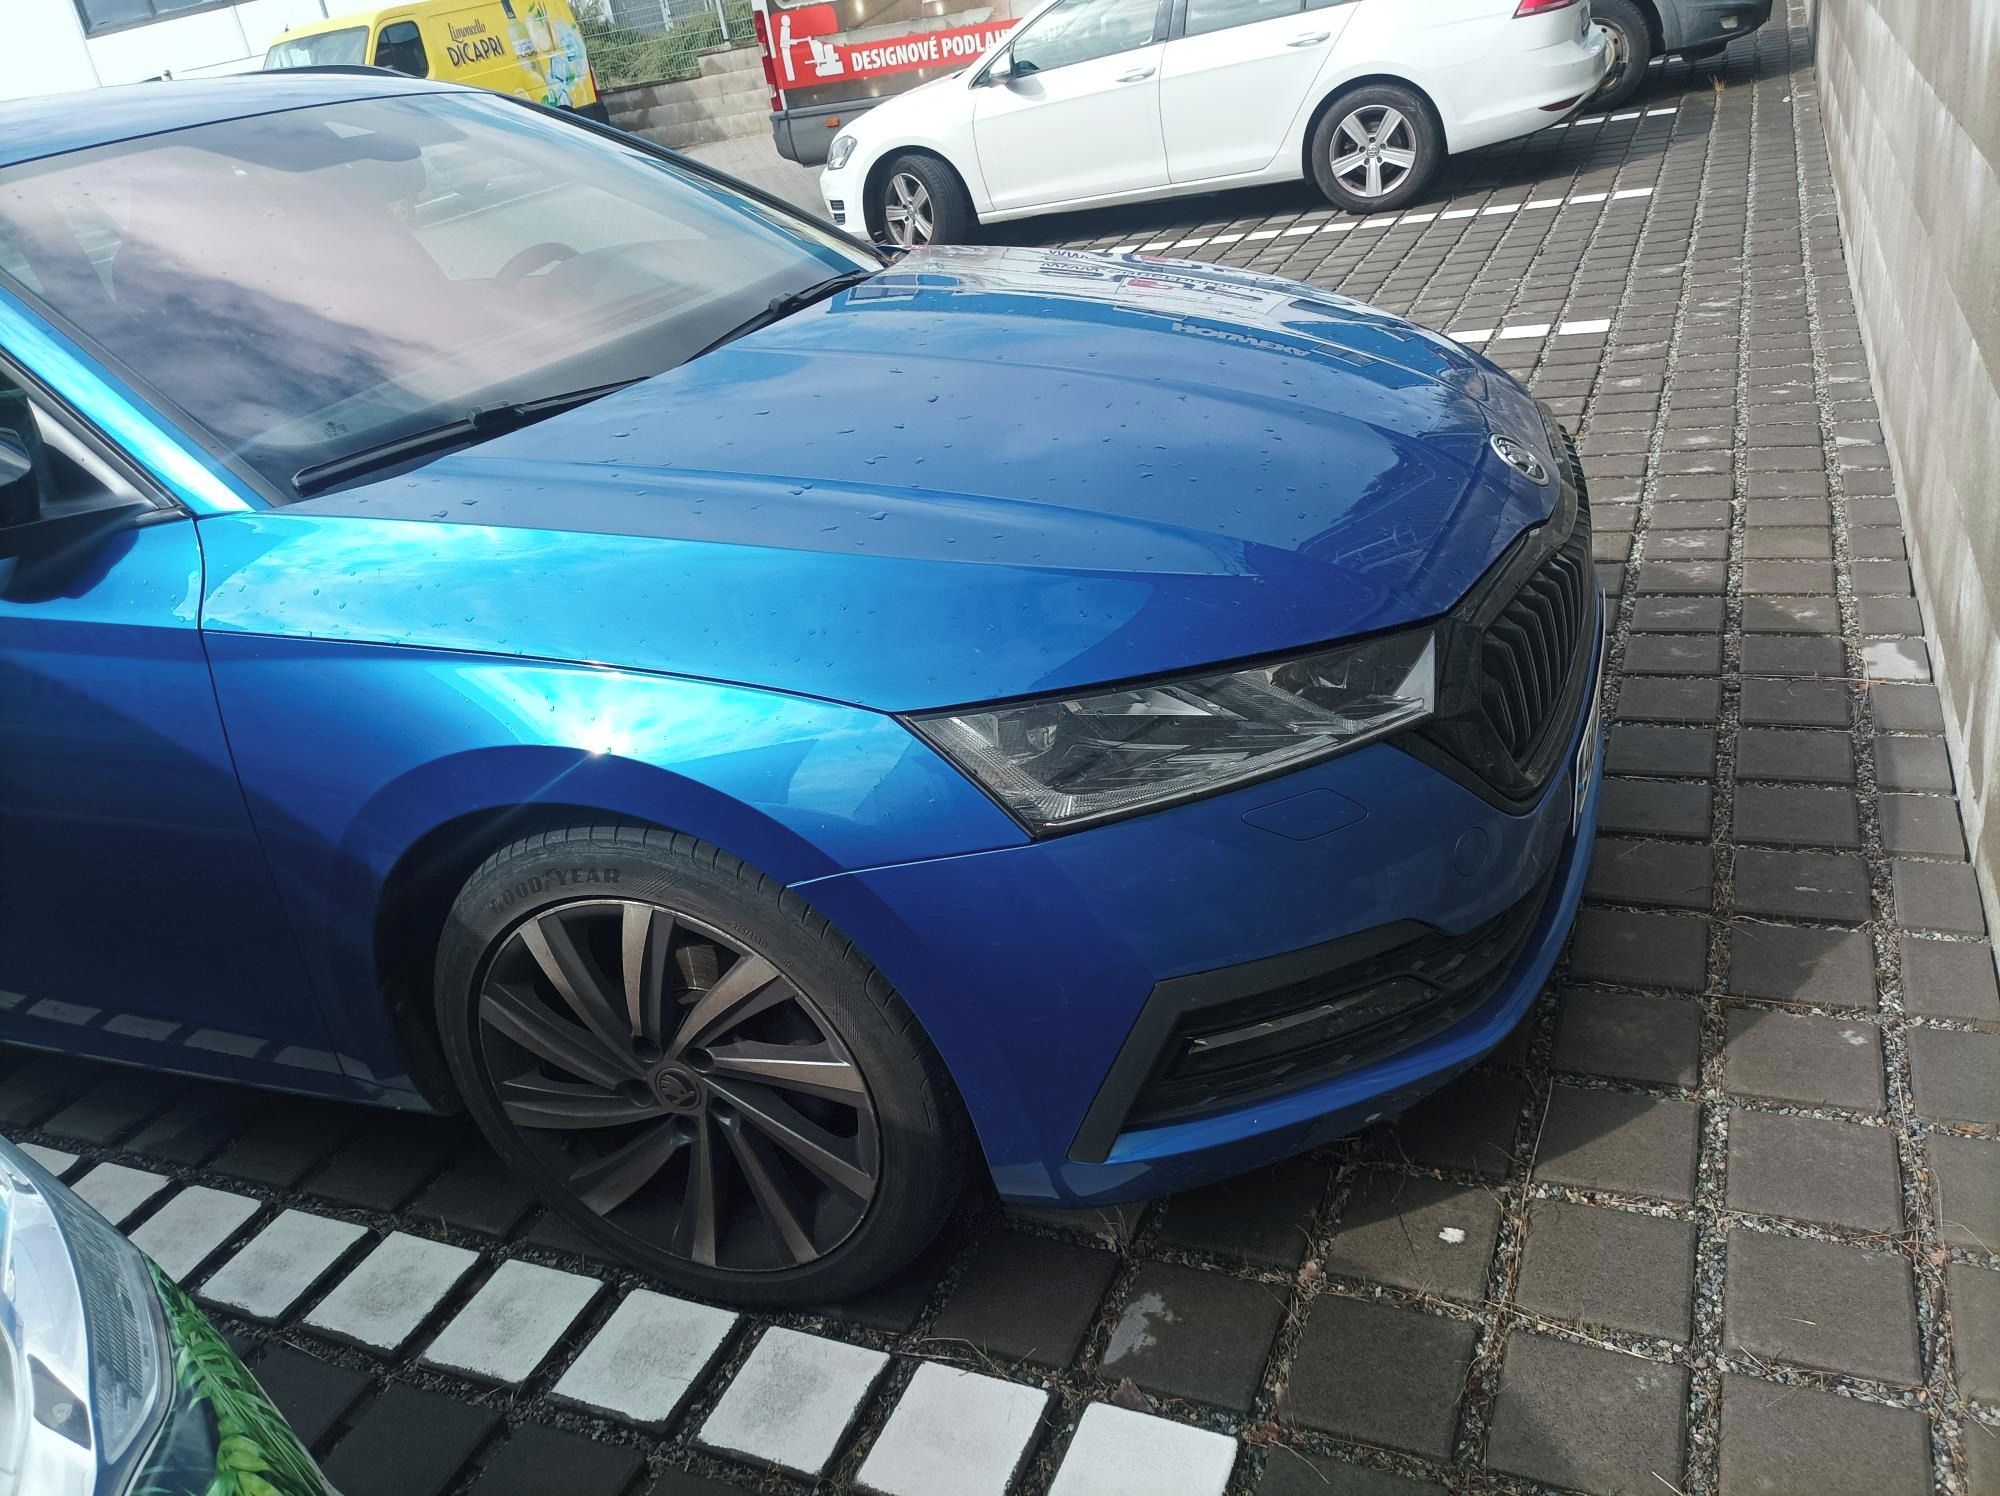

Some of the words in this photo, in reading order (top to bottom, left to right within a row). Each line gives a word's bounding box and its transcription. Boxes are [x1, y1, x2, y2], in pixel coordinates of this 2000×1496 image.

[447, 19, 487, 43] Limoncello
[446, 36, 505, 68] DICAPRI
[851, 37, 939, 72] DESIGNOVÉ
[942, 29, 1008, 58] PODLA
